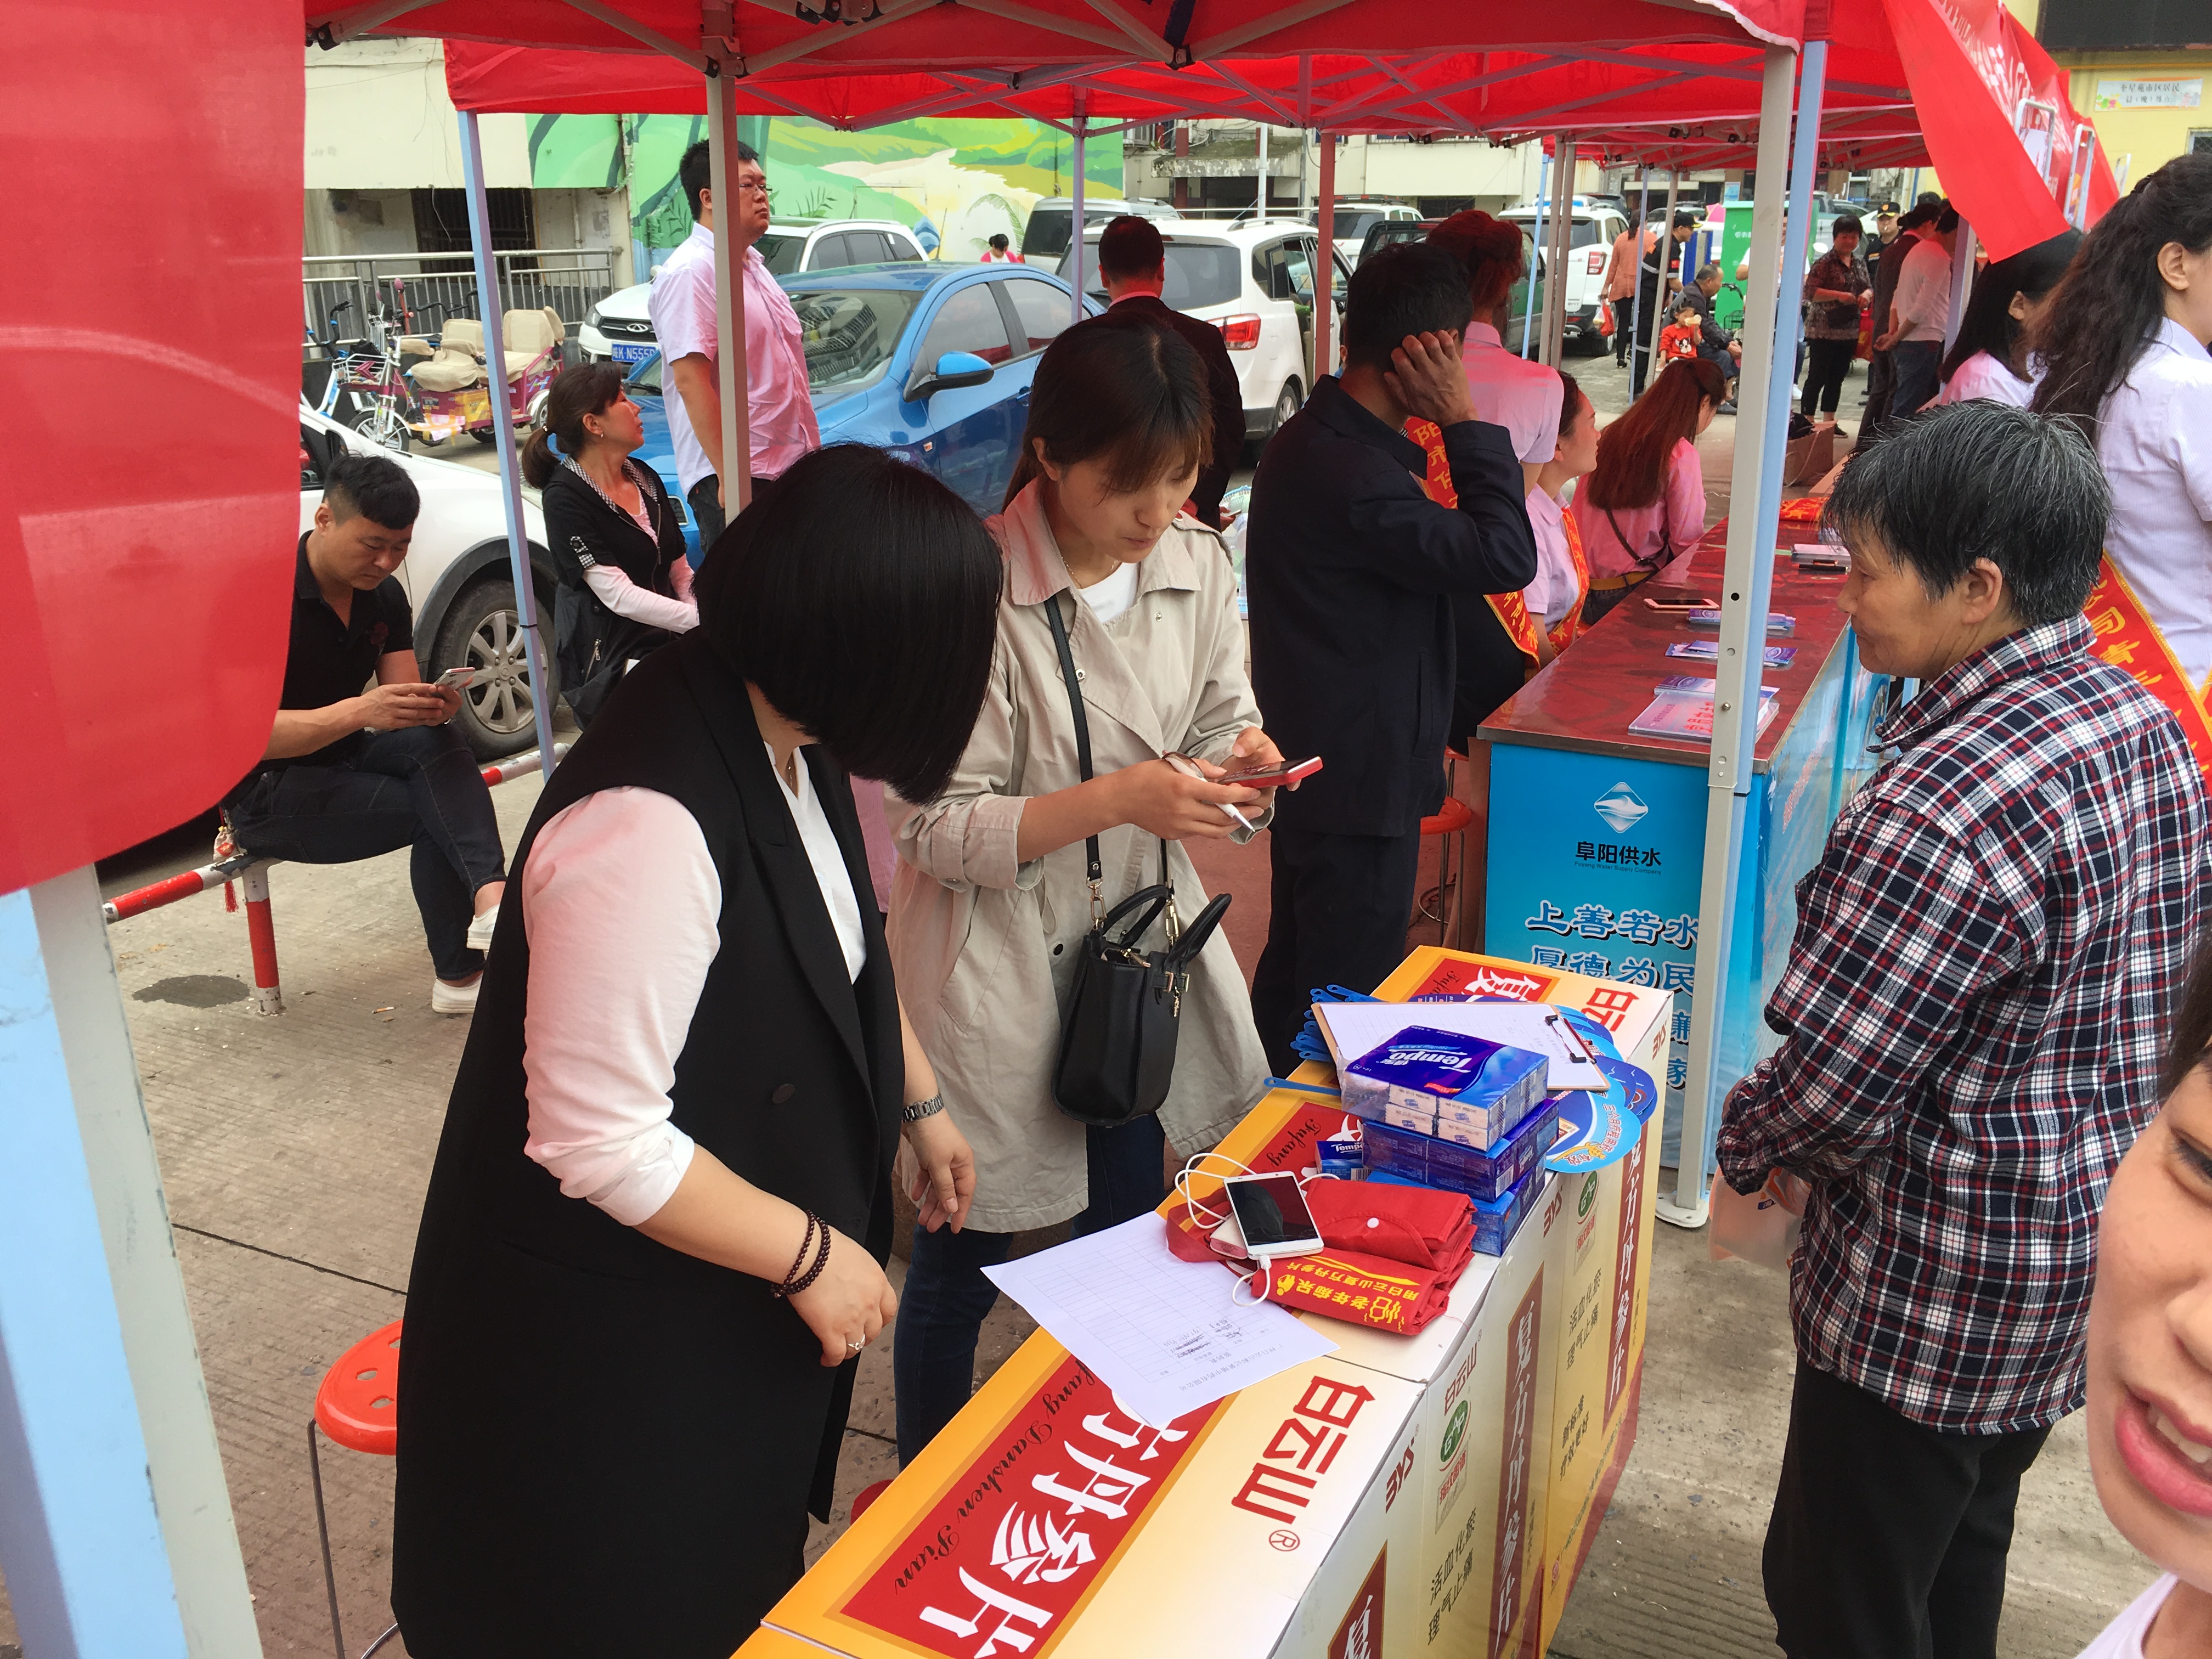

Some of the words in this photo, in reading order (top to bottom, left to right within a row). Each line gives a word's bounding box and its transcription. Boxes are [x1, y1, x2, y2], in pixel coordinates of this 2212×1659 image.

[1575, 841, 1662, 867] 阜阳供水
[1634, 867, 1662, 876] Company
[1525, 899, 1700, 949] 上善若水
[1388, 1049, 1472, 1073] Tempo
[1266, 1118, 1322, 1169] Fufang
[1597, 1103, 1622, 1153] 三个月疗程用药
[1564, 1153, 1592, 1166] 有效
[1581, 1179, 1596, 1211] GAP
[1286, 1261, 1420, 1301] 用白云山复方丹参片
[1569, 1267, 1601, 1337] 活血化瘀
[1209, 1351, 1232, 1364] 签到表
[1566, 1302, 1599, 1372] 理气止痛
[1444, 1341, 1477, 1417] 白云山
[1231, 1375, 1376, 1525] 白云山
[1444, 1411, 1465, 1455] GAP
[956, 1420, 1053, 1523] Danshen
[1494, 1300, 1535, 1658] 复方丹参片
[894, 1525, 960, 1595] Pian
[1430, 1507, 1476, 1606] 活血化瘀
[1427, 1548, 1474, 1646] 理气止痛
